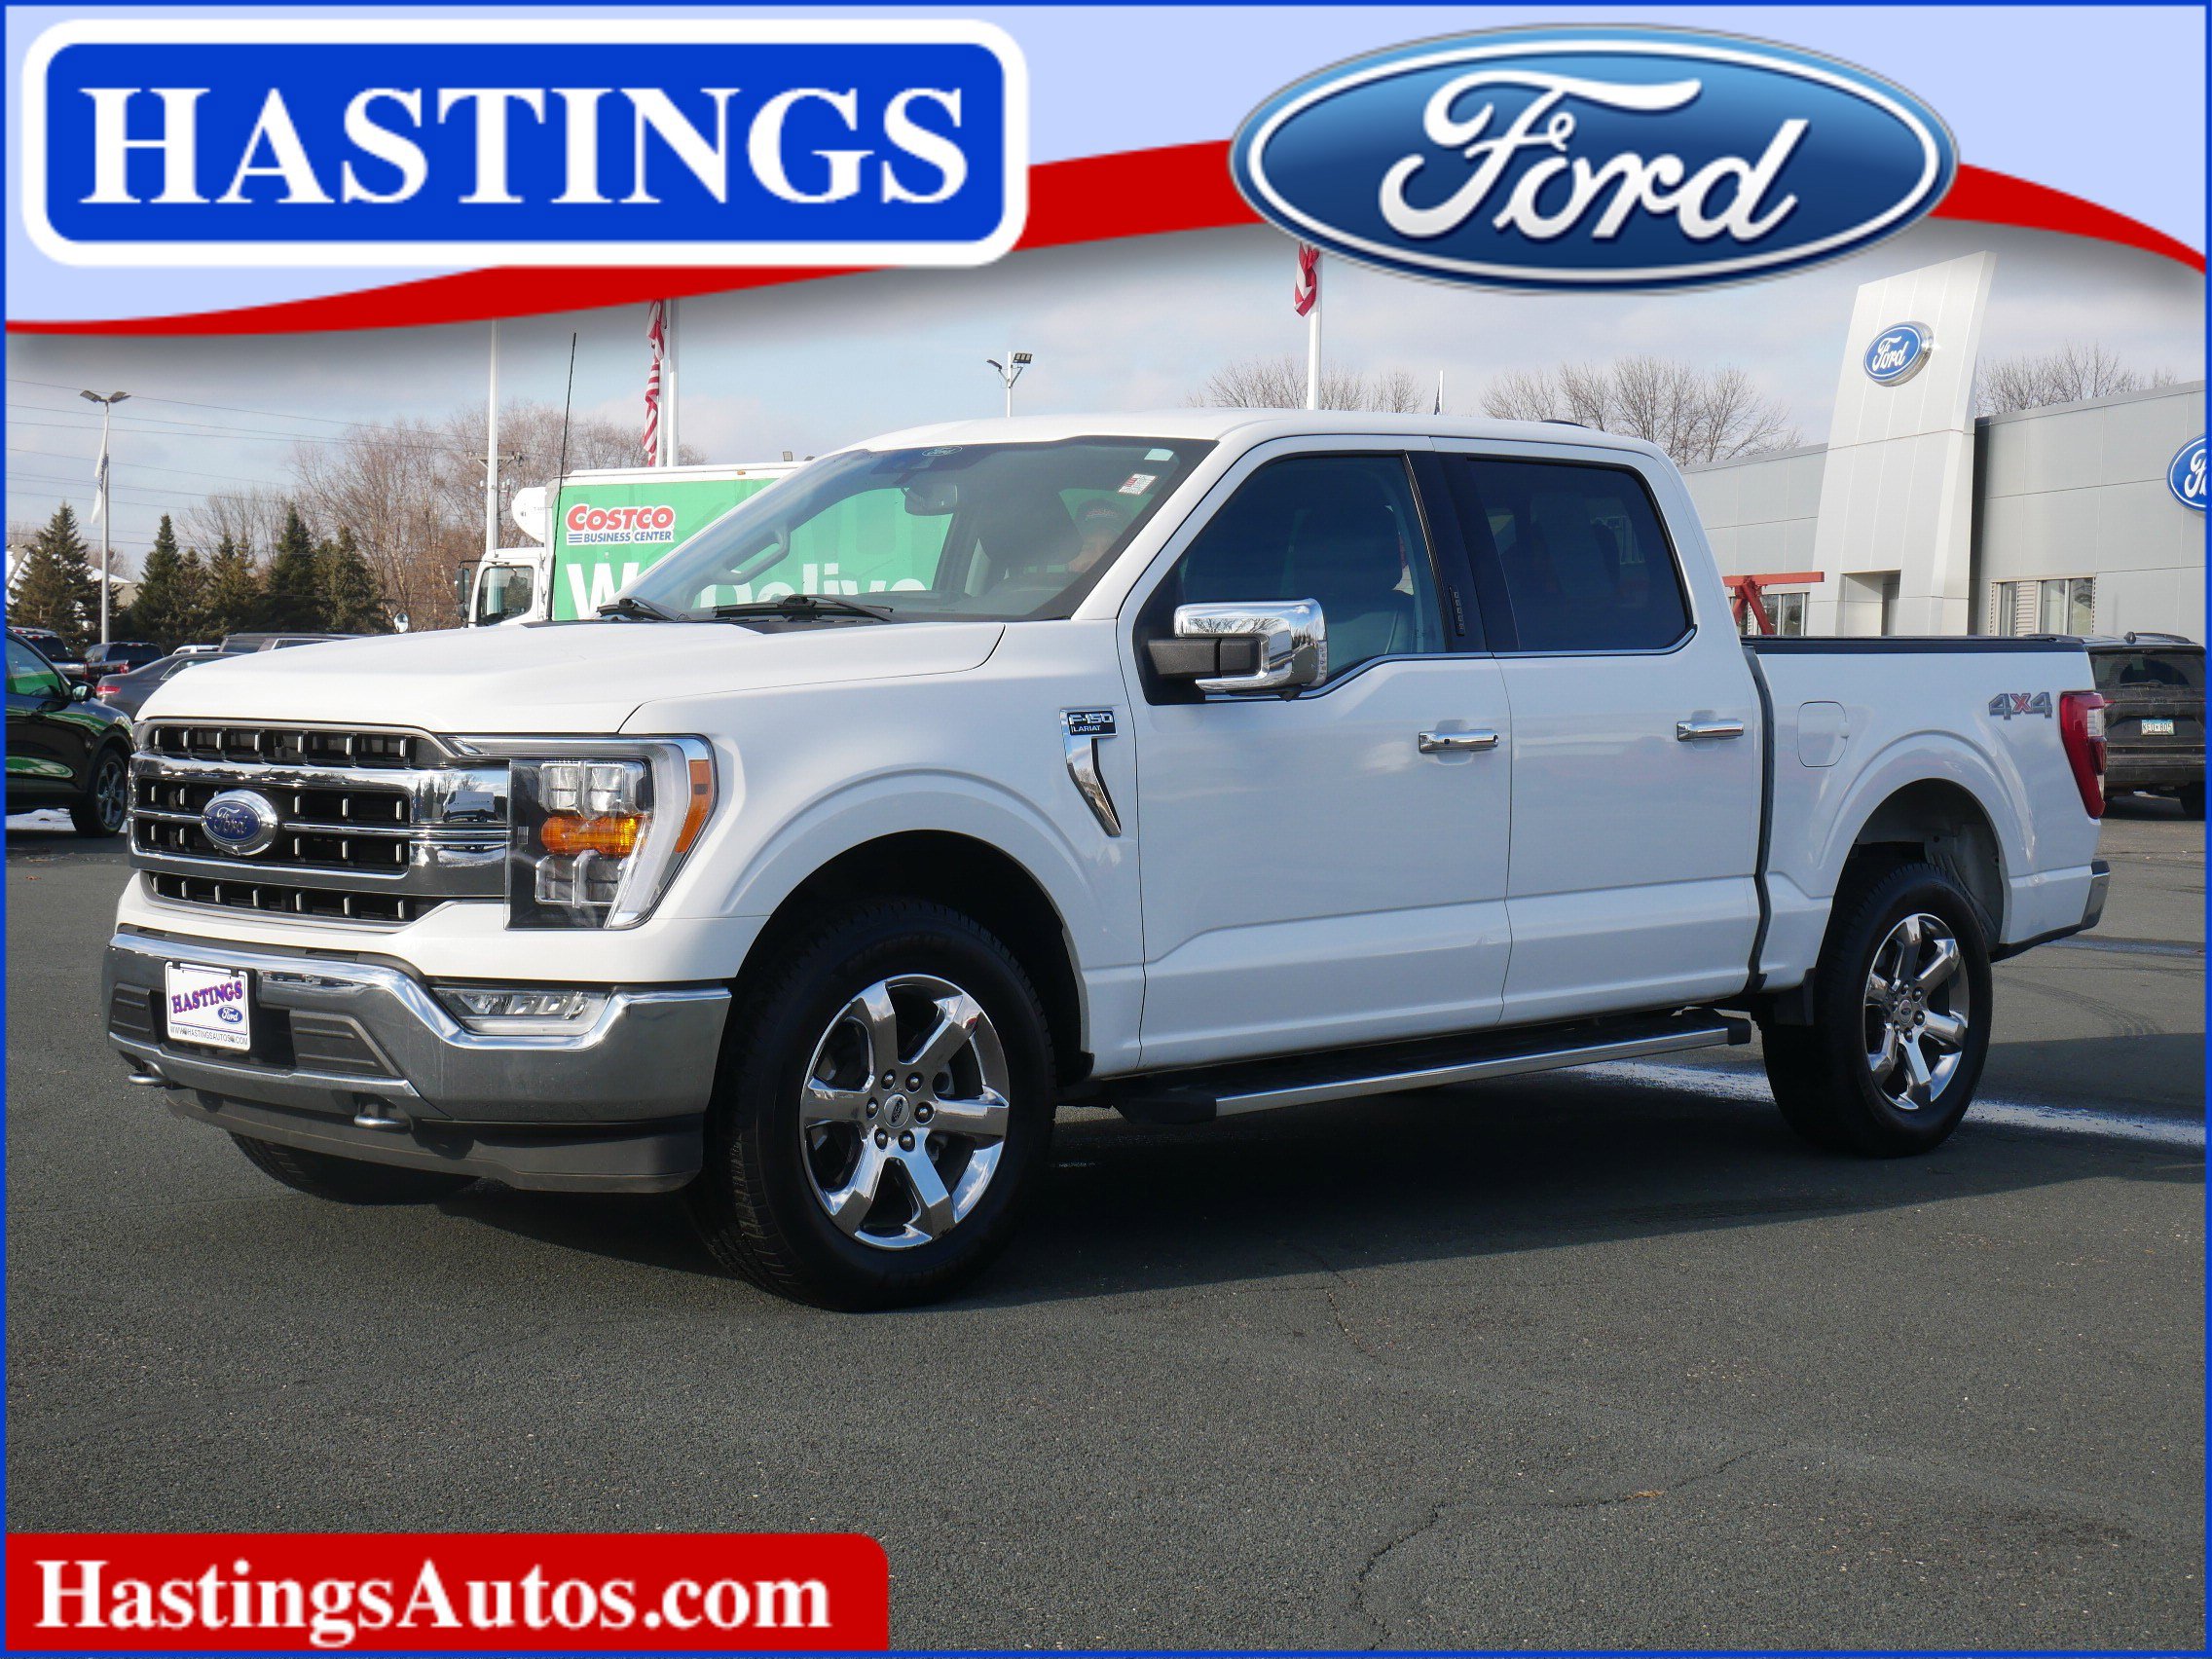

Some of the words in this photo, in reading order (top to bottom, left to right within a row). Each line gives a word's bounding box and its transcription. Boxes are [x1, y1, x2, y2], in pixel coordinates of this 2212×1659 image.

[1871, 336, 1909, 371] Ford
[567, 505, 674, 531] COSTCO
[584, 532, 631, 543] BUSINESS
[634, 531, 672, 541] CENTER
[1068, 712, 1114, 725] F-150
[214, 806, 248, 834] Ford
[171, 980, 243, 1014] HASTINGS
[221, 1007, 240, 1021] Ford
